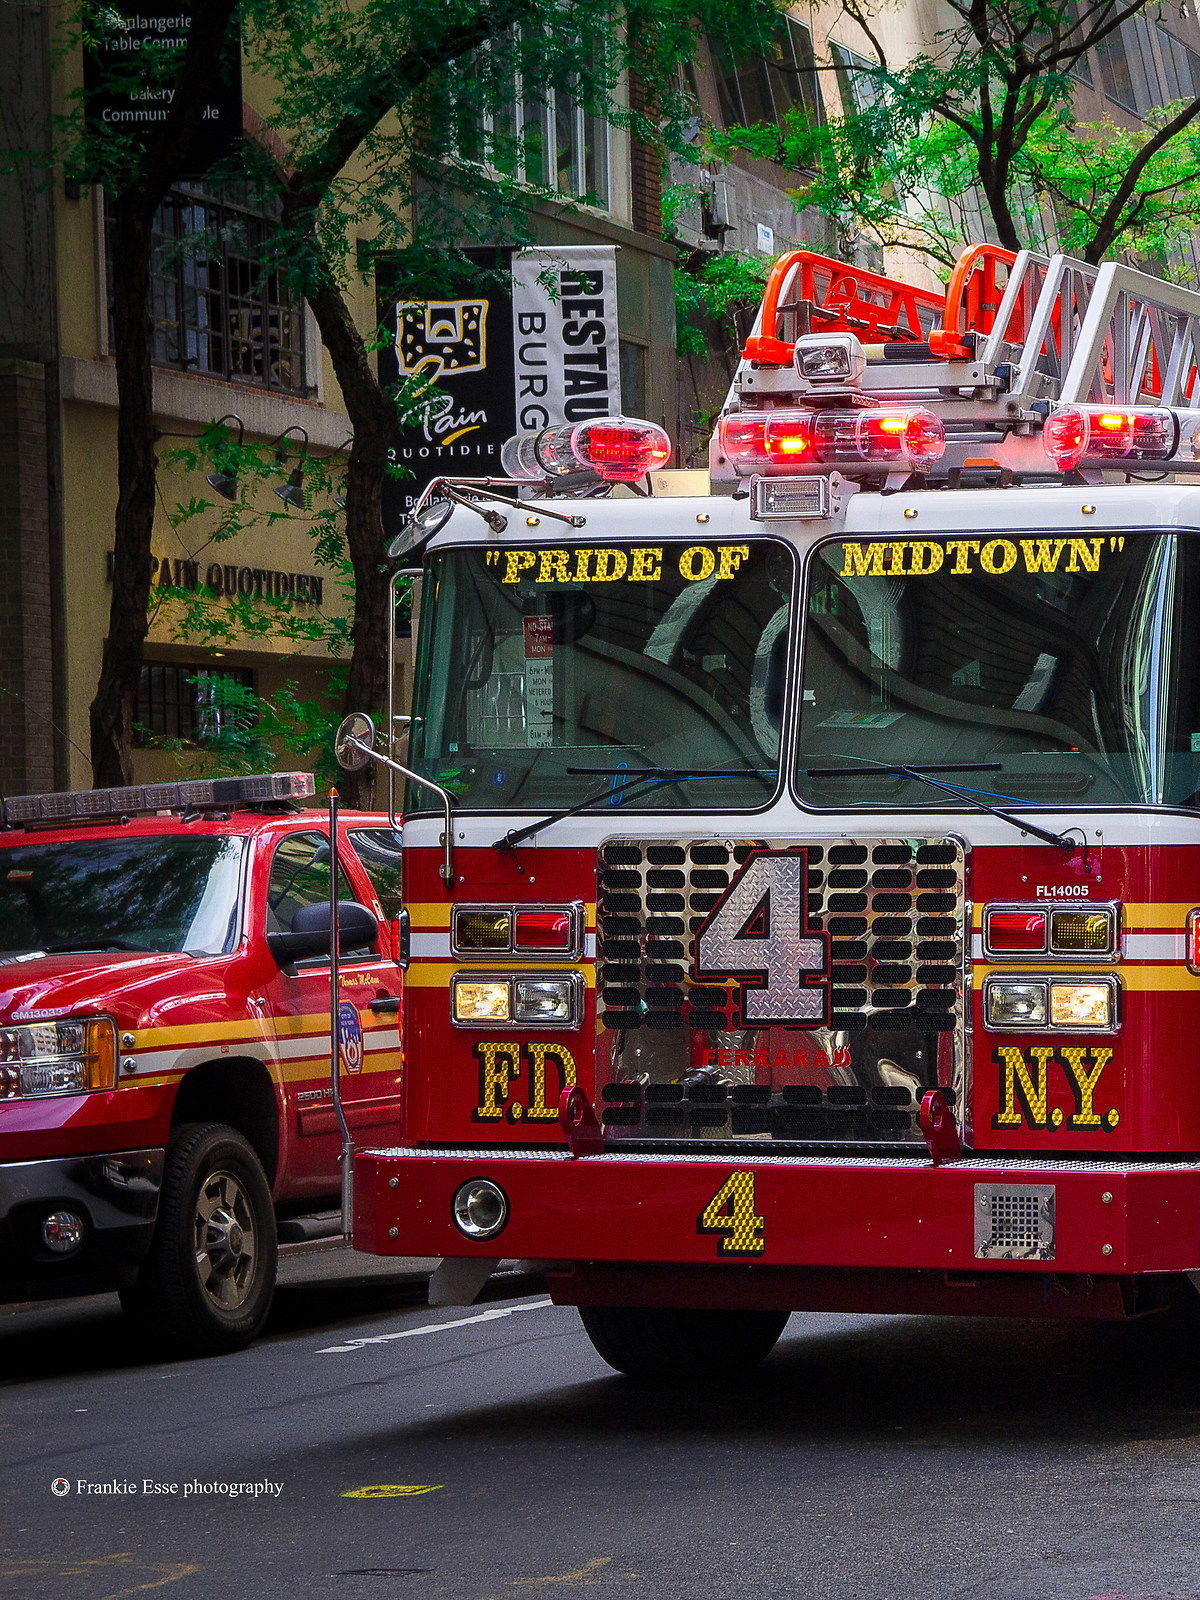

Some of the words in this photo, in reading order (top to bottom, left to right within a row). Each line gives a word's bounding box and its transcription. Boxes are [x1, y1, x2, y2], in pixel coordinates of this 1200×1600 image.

[423, 395, 488, 441] Pain
[387, 444, 506, 460] QUOTIDIE
[486, 548, 664, 584] "PRIDE
[678, 546, 750, 581] OF
[839, 536, 1126, 577] MIDTOWN"
[1036, 885, 1089, 897] FL14005
[695, 848, 831, 1028] 4
[995, 1046, 1121, 1127] N.Y.
[700, 1170, 765, 1252] 4
